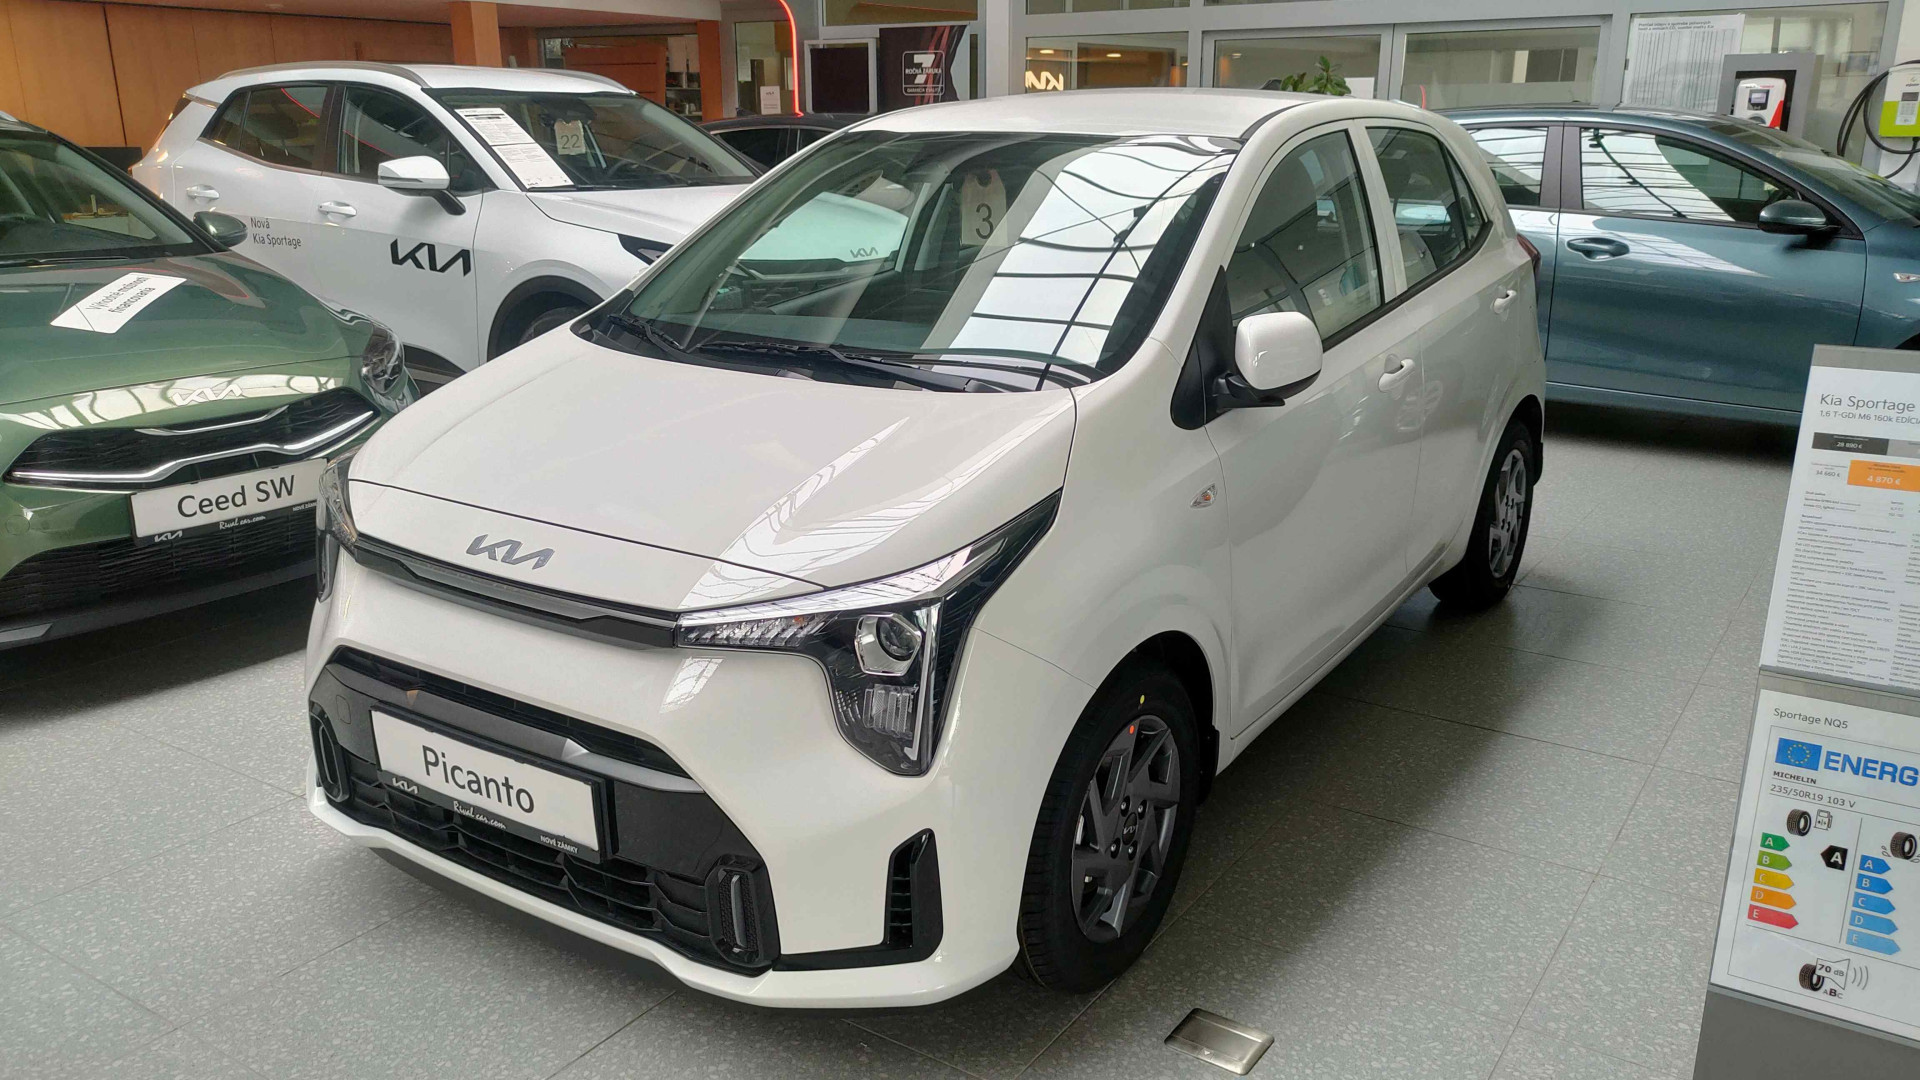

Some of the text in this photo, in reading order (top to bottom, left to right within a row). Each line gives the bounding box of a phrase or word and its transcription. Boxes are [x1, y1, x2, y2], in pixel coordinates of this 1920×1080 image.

[914, 54, 935, 84] 7
[560, 134, 580, 150] 22
[250, 217, 270, 229] Nová
[975, 202, 994, 240] 3
[252, 233, 302, 250] Kia Sportage
[390, 238, 471, 277] KIA
[171, 384, 243, 407] KIA
[1820, 393, 1916, 414] Kia Sportage
[1858, 413, 1871, 421] M6
[1874, 414, 1894, 422] 160k
[1875, 476, 1893, 484] 870
[177, 474, 295, 518] Ceed SW
[154, 530, 183, 543] KIA
[466, 533, 555, 570] KIA
[1773, 707, 1849, 729] Sportage NQ5
[1823, 750, 1920, 787] ENERG
[422, 744, 535, 814] Picanto
[1773, 770, 1817, 785] MICHELIN
[392, 777, 419, 795] KIA
[1770, 784, 1856, 808] 235/50R19 103 V
[540, 835, 556, 847] NOVÉ
[1765, 837, 1773, 847] A
[1762, 856, 1770, 865] B
[1830, 852, 1843, 865] A
[1864, 860, 1873, 869] A
[1759, 873, 1767, 883] C
[1861, 878, 1870, 887] B
[1755, 890, 1764, 900] D
[1858, 897, 1866, 907] C
[1752, 909, 1759, 919] E
[1855, 915, 1863, 925] D
[1852, 934, 1859, 944] E
[1817, 963, 1844, 977] 70 dB
